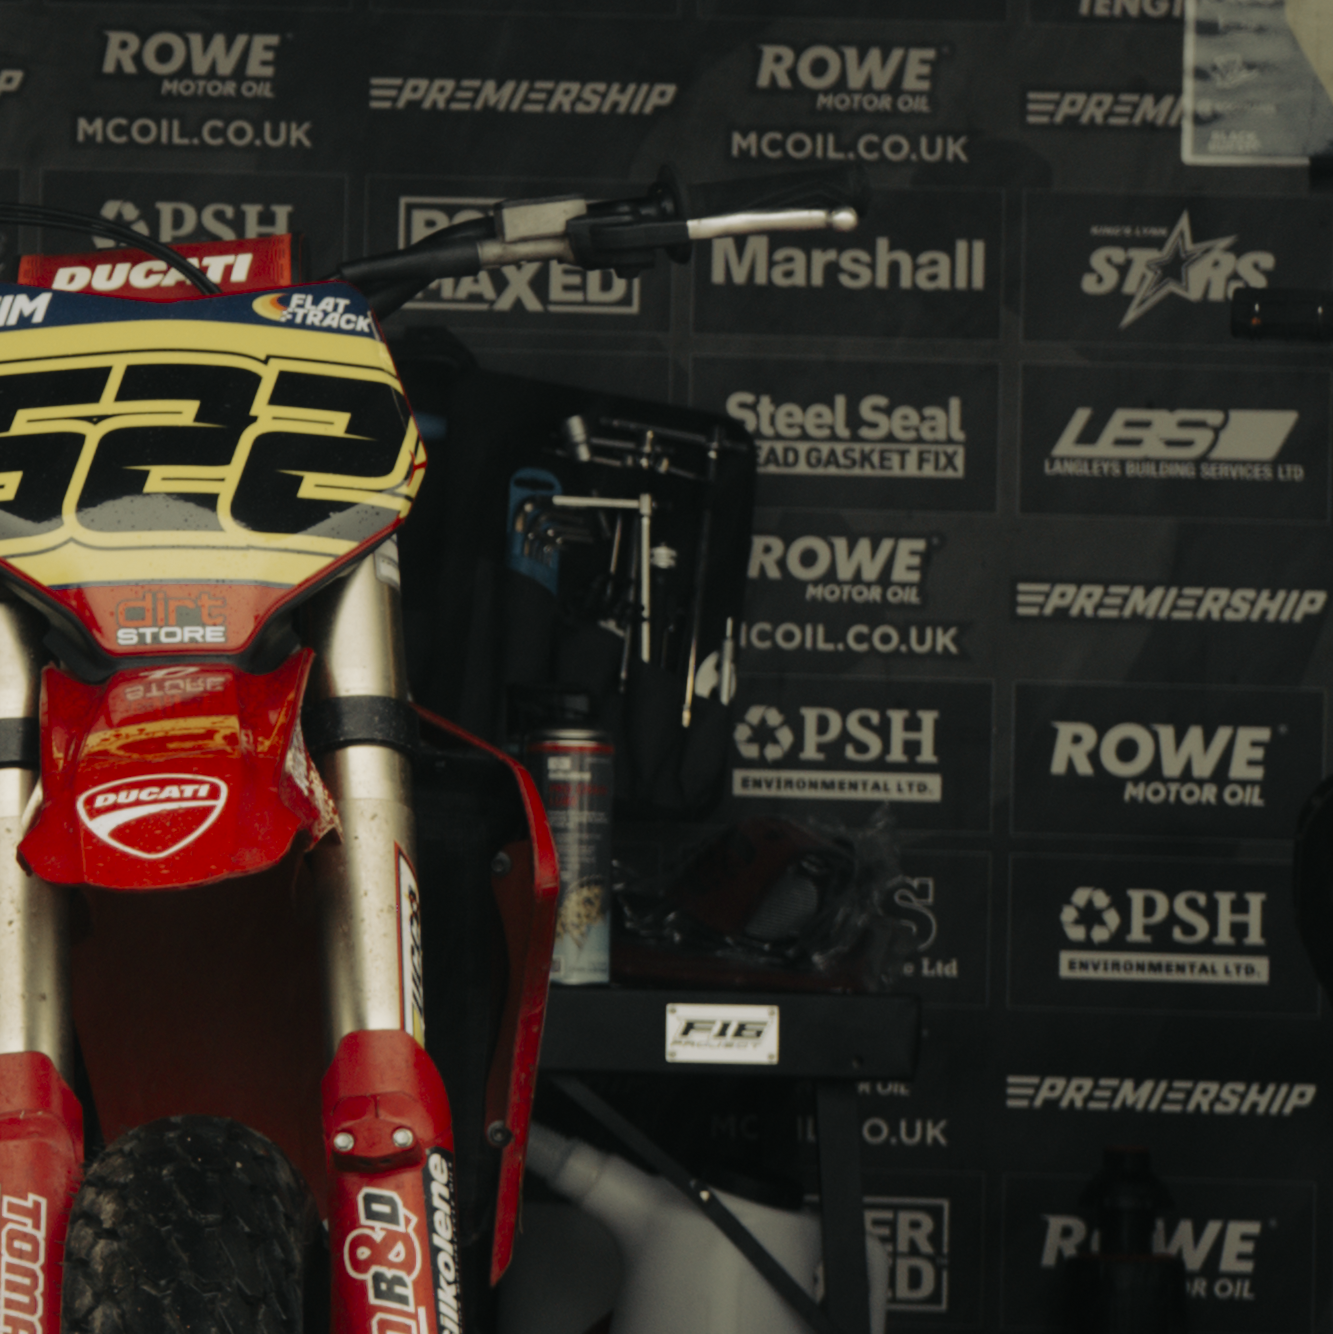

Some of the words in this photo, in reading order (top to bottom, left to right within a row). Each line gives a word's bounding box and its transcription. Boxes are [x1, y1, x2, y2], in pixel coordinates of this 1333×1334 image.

[102, 30, 281, 78] ROWE
[756, 43, 936, 91] ROWE
[161, 78, 236, 98] MOTOR
[241, 79, 275, 99] OIL
[396, 77, 678, 115] PREMIERSHIP
[816, 91, 892, 112] MOTOR
[896, 93, 931, 113] OIL
[76, 117, 313, 149] MCOIL.CO.UK
[731, 131, 969, 164] MCOIL.CO.UK
[51, 252, 254, 293] DUCATI
[710, 237, 986, 291] Marshall
[288, 293, 350, 314] FLAT
[291, 309, 371, 333] TRACK
[725, 390, 847, 441] Steel
[857, 394, 965, 442] Seal
[805, 446, 910, 473] GASKET
[916, 448, 960, 475] FIX
[1125, 460, 1196, 479] BUILDING
[1201, 461, 1273, 480] SERVICES
[1277, 463, 1304, 481] LTD
[748, 535, 929, 584] ROWE
[116, 589, 227, 628] dirt
[805, 583, 882, 604] MOTOR
[886, 585, 921, 605] OIL
[1044, 583, 1327, 623] PREMIERSHIP
[117, 625, 226, 646] STORE
[800, 706, 939, 764] PSH
[1050, 721, 1272, 780] ROWE
[93, 783, 211, 809] DUCATI
[740, 777, 890, 794] ENVIRONMENTAL
[1123, 781, 1221, 806] MOTOR
[1226, 783, 1265, 807] OIL
[1126, 890, 1267, 946] PSH
[1067, 960, 1216, 976] ENVIRONMENTAL
[1035, 1075, 1317, 1116] PREMIERSHIP
[343, 1185, 423, 1311] R&D
[1213, 1276, 1256, 1300] OIL
